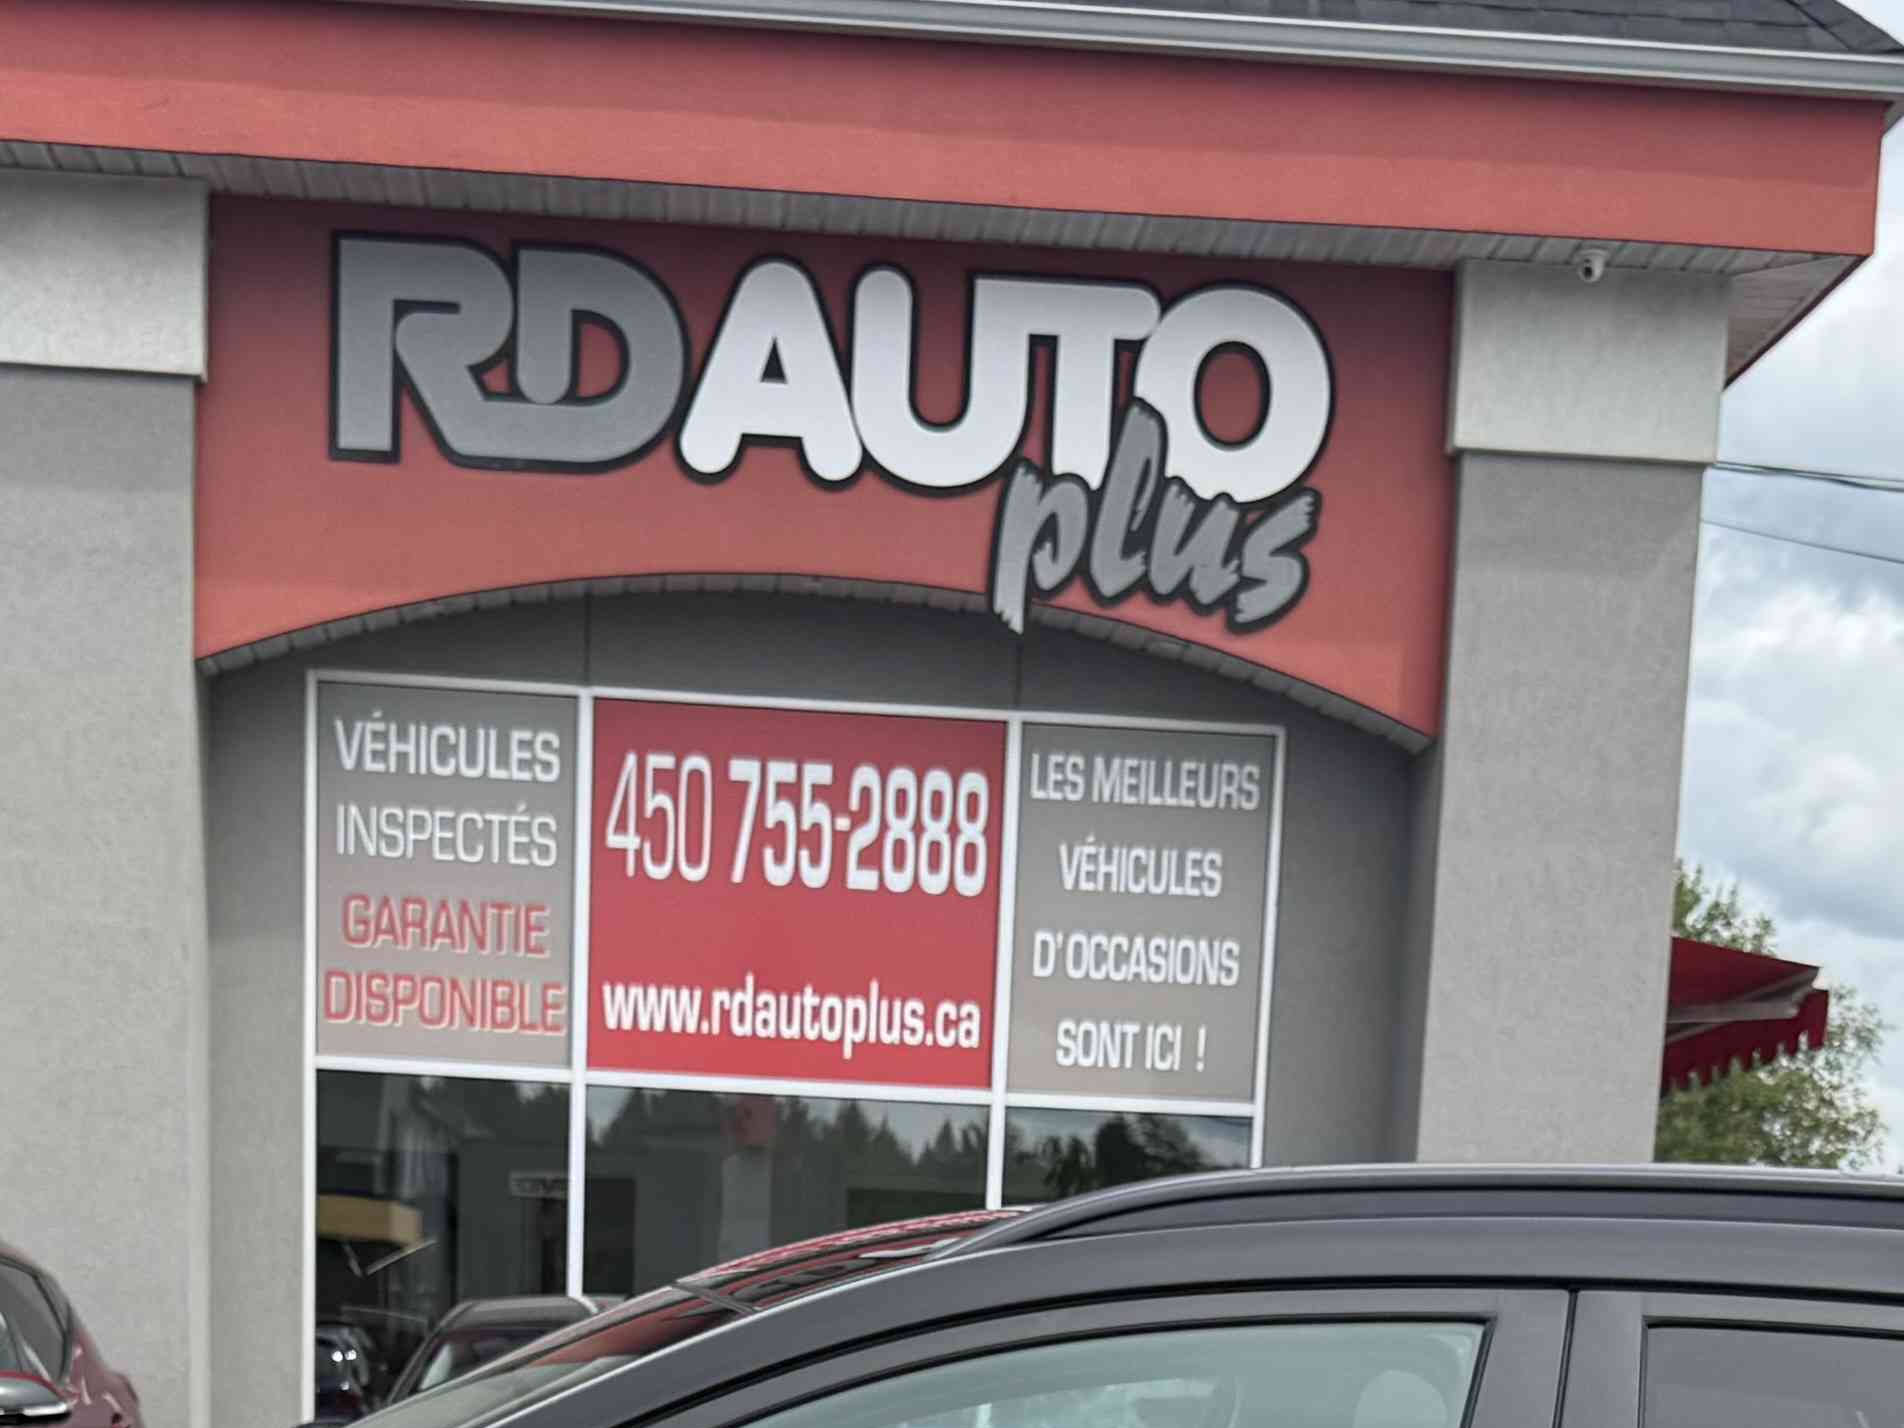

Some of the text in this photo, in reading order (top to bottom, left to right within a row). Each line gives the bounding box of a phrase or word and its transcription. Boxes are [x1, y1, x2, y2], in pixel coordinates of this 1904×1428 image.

[992, 398, 1322, 635] plus
[334, 709, 561, 783] VÉHICULES
[1029, 752, 1260, 811] LES MEILLEURS
[336, 801, 558, 867] INSPECTÉS
[604, 750, 990, 897] 450 755-2888
[1058, 833, 1224, 898] VÉHICULES
[342, 893, 552, 960] GARANTIE
[323, 969, 568, 1038] DISPONIBLE
[600, 970, 982, 1061] www.rdautoplus.ca
[1055, 1016, 1141, 1069] SONT
[1145, 1023, 1184, 1072] ICI
